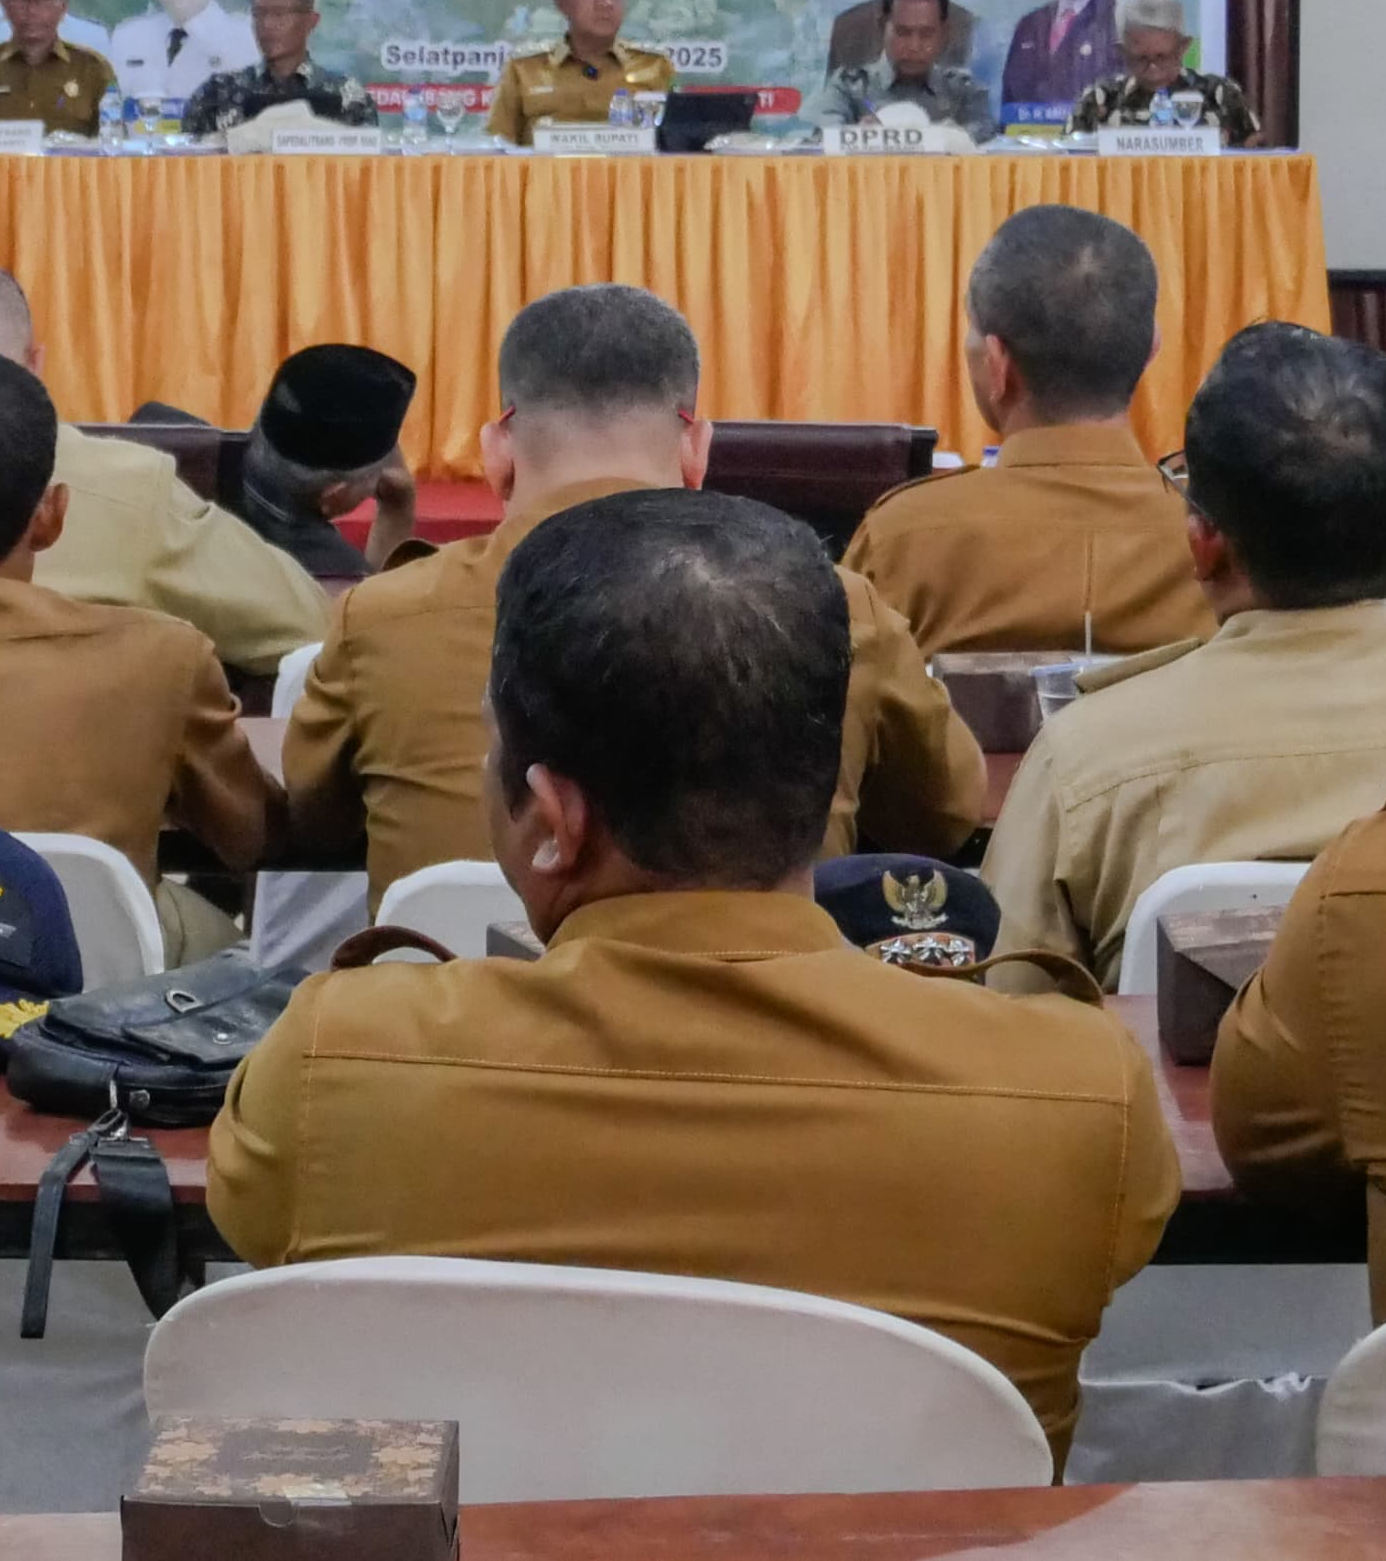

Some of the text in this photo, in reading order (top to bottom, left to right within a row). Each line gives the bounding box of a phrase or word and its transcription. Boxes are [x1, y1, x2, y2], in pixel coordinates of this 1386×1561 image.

[549, 133, 638, 143] WAKIL BUPATI
[840, 128, 923, 145] DPRD
[1116, 136, 1204, 153] NARASUMBER
